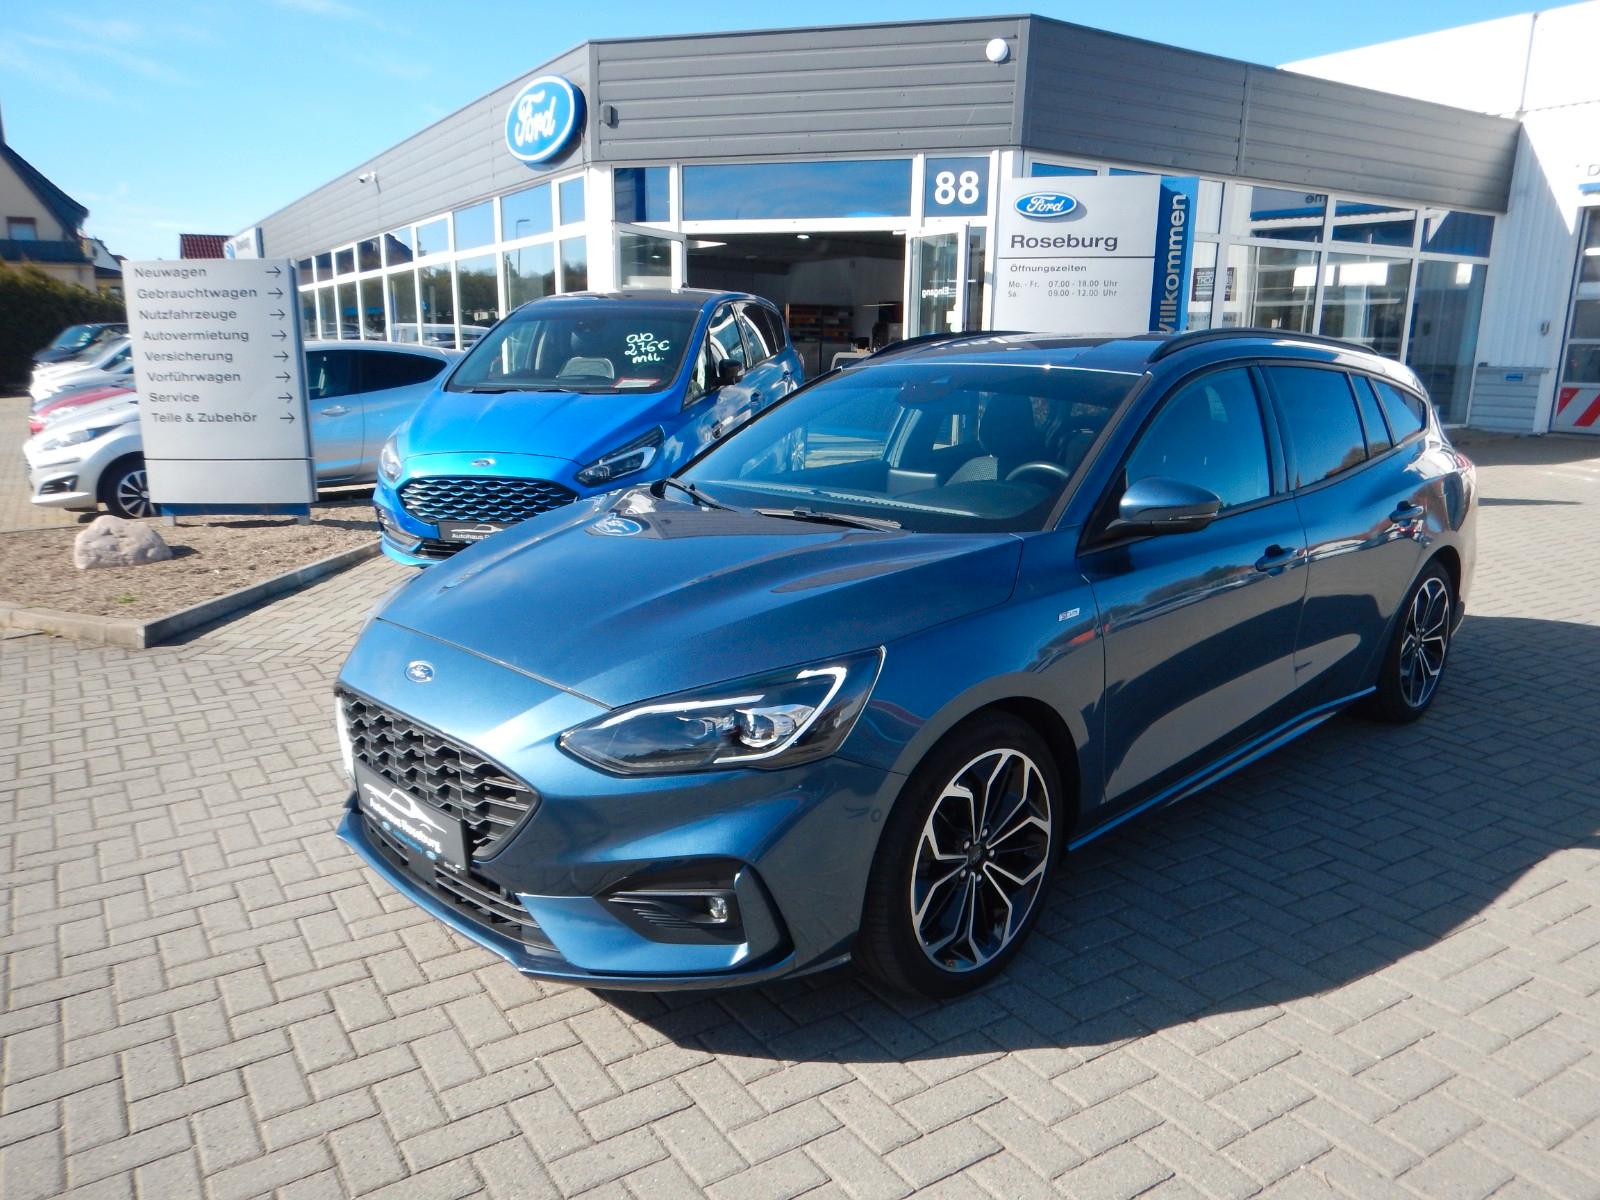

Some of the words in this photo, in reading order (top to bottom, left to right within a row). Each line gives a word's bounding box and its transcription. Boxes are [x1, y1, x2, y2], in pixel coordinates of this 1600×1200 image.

[515, 89, 557, 147] Ford
[934, 171, 979, 205] 88
[1026, 195, 1064, 214] Ford
[1010, 234, 1118, 251] Roseburg
[134, 267, 207, 280] Neuwagen
[1010, 263, 1087, 273] Öffnungszeiten
[137, 287, 258, 300] Gebrauchtwagen
[1048, 289, 1070, 297] 09.00
[1078, 289, 1099, 297] 12.00
[138, 309, 237, 321] Nutzfahrzeuge
[143, 330, 249, 343] Autovermietung
[625, 332, 654, 344] ab
[144, 351, 233, 364] Versicherung
[146, 371, 241, 384] Vorführwagen
[148, 392, 199, 403] Service
[151, 412, 182, 423] Teile
[185, 412, 194, 423] &
[198, 411, 257, 423] Zubehör
